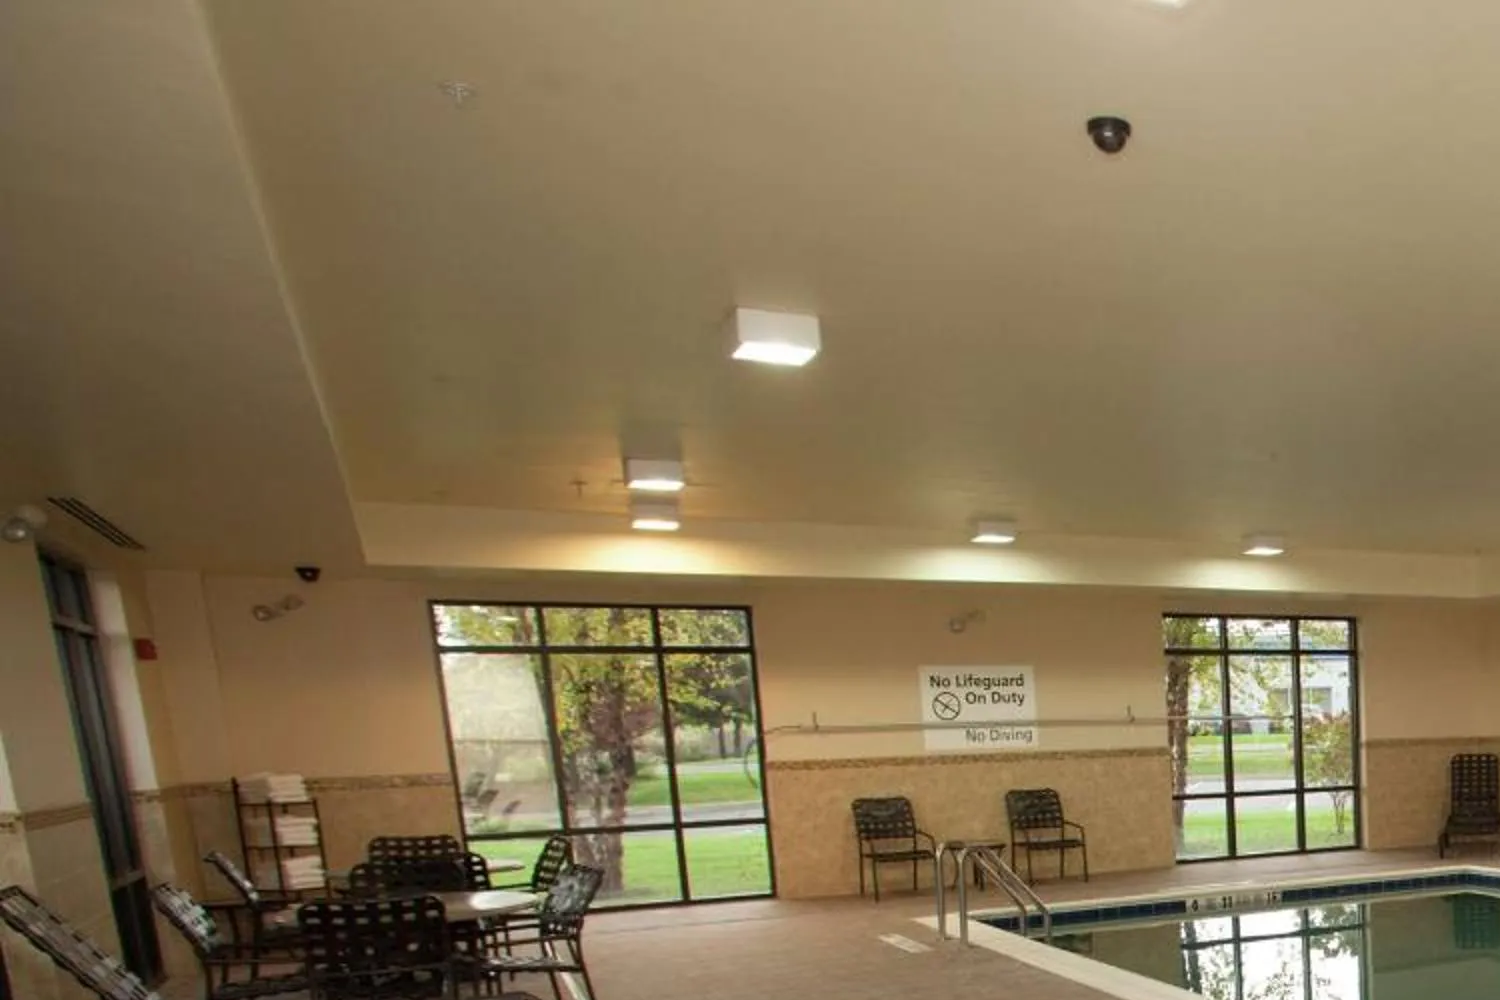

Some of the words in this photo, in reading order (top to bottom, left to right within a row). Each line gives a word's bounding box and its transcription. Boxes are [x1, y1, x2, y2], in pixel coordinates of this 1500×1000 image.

[929, 674, 951, 688] No
[955, 673, 1025, 691] Lifeguard
[965, 691, 987, 705] On
[991, 691, 1025, 707] Duty
[965, 728, 986, 743] No
